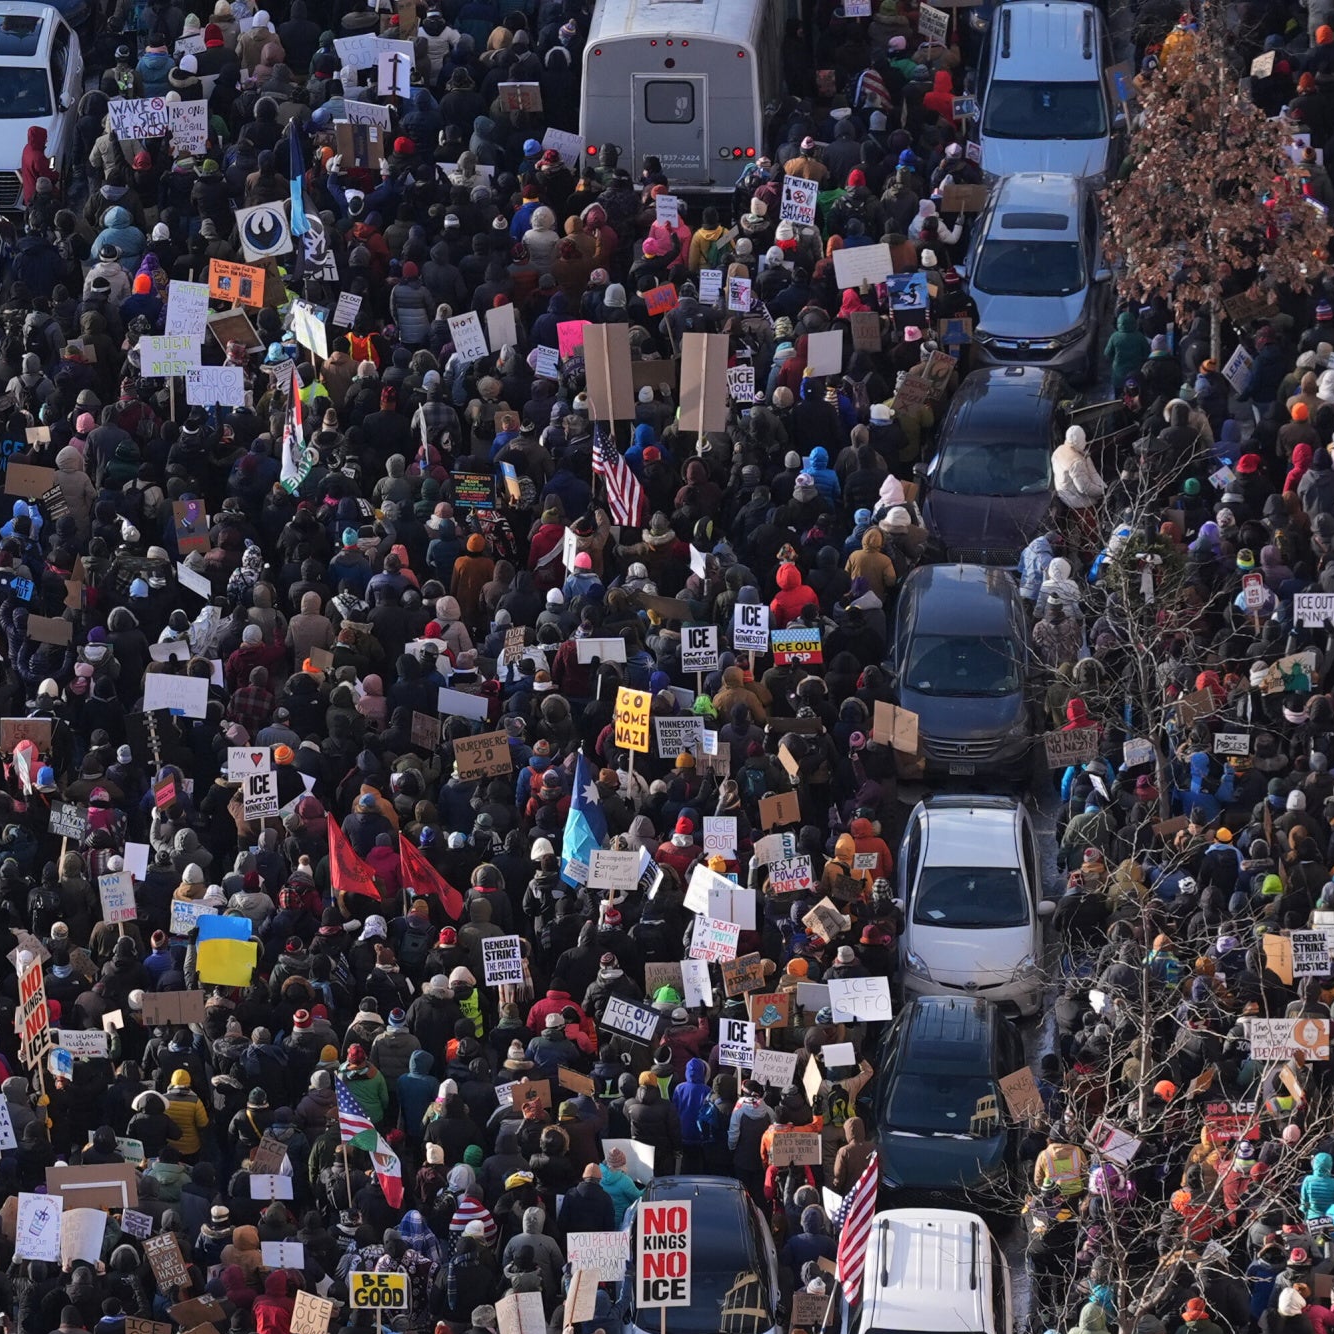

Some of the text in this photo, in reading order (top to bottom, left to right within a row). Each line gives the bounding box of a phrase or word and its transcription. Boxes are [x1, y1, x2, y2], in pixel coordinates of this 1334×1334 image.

[110, 99, 149, 115] WAKE
[349, 114, 387, 130] NOW
[453, 317, 473, 329] HOT
[461, 347, 484, 359] ICE
[1229, 352, 1246, 379] LEAVE
[1298, 596, 1334, 609] ICE OUT
[742, 606, 761, 627] ICE
[688, 628, 709, 649] ICE
[735, 634, 767, 646] MINNESOTA
[773, 642, 819, 652] ICE OUT
[683, 656, 717, 666] MINNESOTA
[617, 710, 647, 726] HOME
[659, 720, 701, 729] MINNESOTA:
[616, 729, 645, 746] NAZI
[660, 729, 682, 738] RESIST
[455, 736, 508, 753] NUREMBERG
[661, 737, 681, 746] DEFEND
[473, 752, 494, 764] 2.0
[662, 746, 680, 755] FIGHT
[250, 774, 270, 796] ICE
[246, 801, 278, 813] MINNESOTA
[706, 819, 734, 832] ICE
[705, 835, 733, 850] OUT
[769, 856, 810, 872] REST IN
[100, 877, 120, 886] MN
[774, 867, 807, 882] POWER
[484, 940, 518, 950] GENERAL
[1292, 933, 1326, 942] GENERAL
[1292, 942, 1327, 953] STRIKE:
[485, 950, 519, 961] STRIKE:
[1294, 962, 1328, 972] JUSTICE
[21, 964, 39, 993] NO
[487, 971, 521, 982] JUSTICE
[841, 979, 880, 994] ICE
[23, 989, 40, 1018] KINGS
[756, 994, 786, 1005] FUCK
[834, 994, 890, 1013] GTFO
[609, 1000, 660, 1025] ICE OUT
[25, 1003, 43, 1039] NO
[613, 1017, 646, 1036] NOW
[727, 1021, 747, 1043] ICE
[27, 1028, 46, 1059] ICE
[721, 1049, 752, 1061] MINNESOTA
[1207, 1102, 1256, 1114] NO ICE
[643, 1207, 687, 1235] NO
[146, 1234, 173, 1249] ICE
[643, 1235, 687, 1251] KINGS
[643, 1251, 687, 1278] NO
[361, 1274, 389, 1288] BE
[354, 1287, 403, 1307] GOOD
[642, 1279, 686, 1301] ICE
[300, 1292, 332, 1314] ICE
[128, 1319, 164, 1333] ICE
[296, 1308, 328, 1329] OUT
